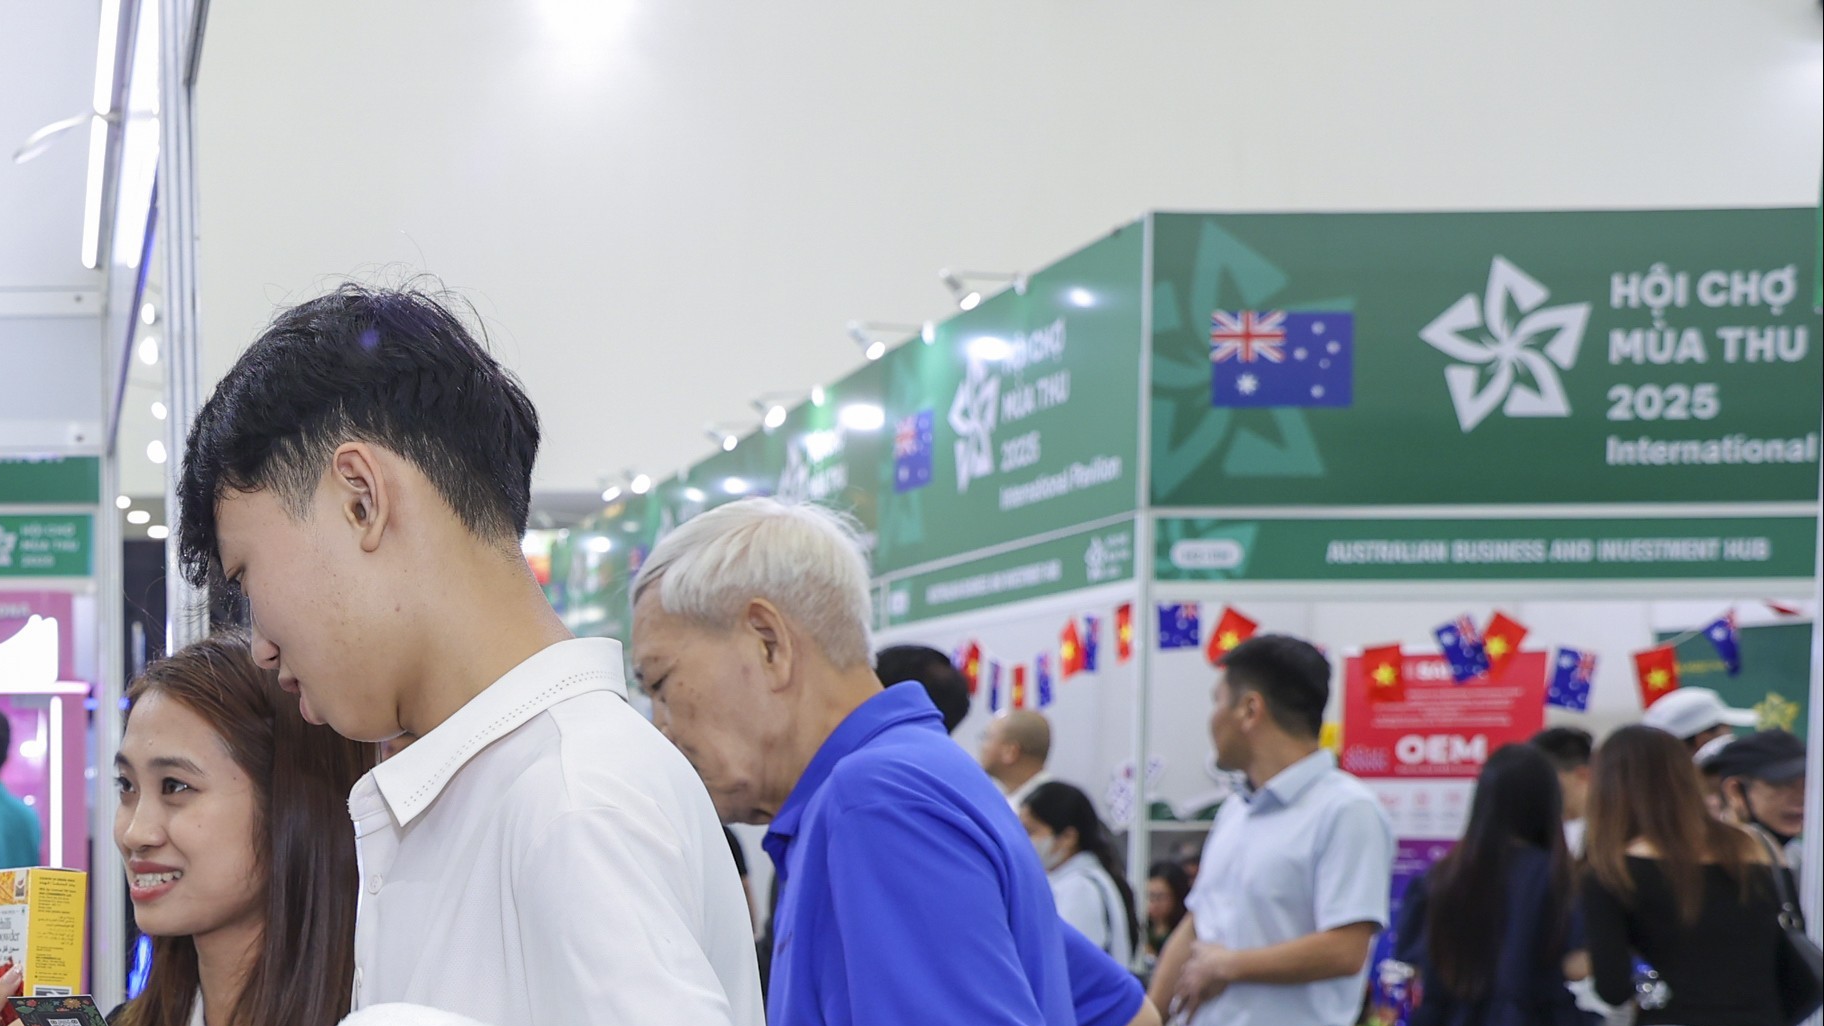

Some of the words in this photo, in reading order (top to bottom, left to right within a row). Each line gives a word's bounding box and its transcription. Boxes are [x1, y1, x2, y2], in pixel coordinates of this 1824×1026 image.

[1610, 262, 1690, 316] HỘI
[1696, 263, 1797, 316] CHỢ
[1608, 318, 1709, 365] MÙA
[1716, 324, 1809, 364] THU
[1606, 382, 1721, 421] 2025
[1605, 431, 1817, 466] International
[1326, 538, 1448, 564] AUSTRALIAN
[1451, 538, 1547, 563] BUSINESS
[1548, 538, 1594, 563] AND
[1597, 537, 1721, 563] INVESTMENT
[1723, 537, 1771, 562] HUB
[1394, 734, 1488, 765] OEM
